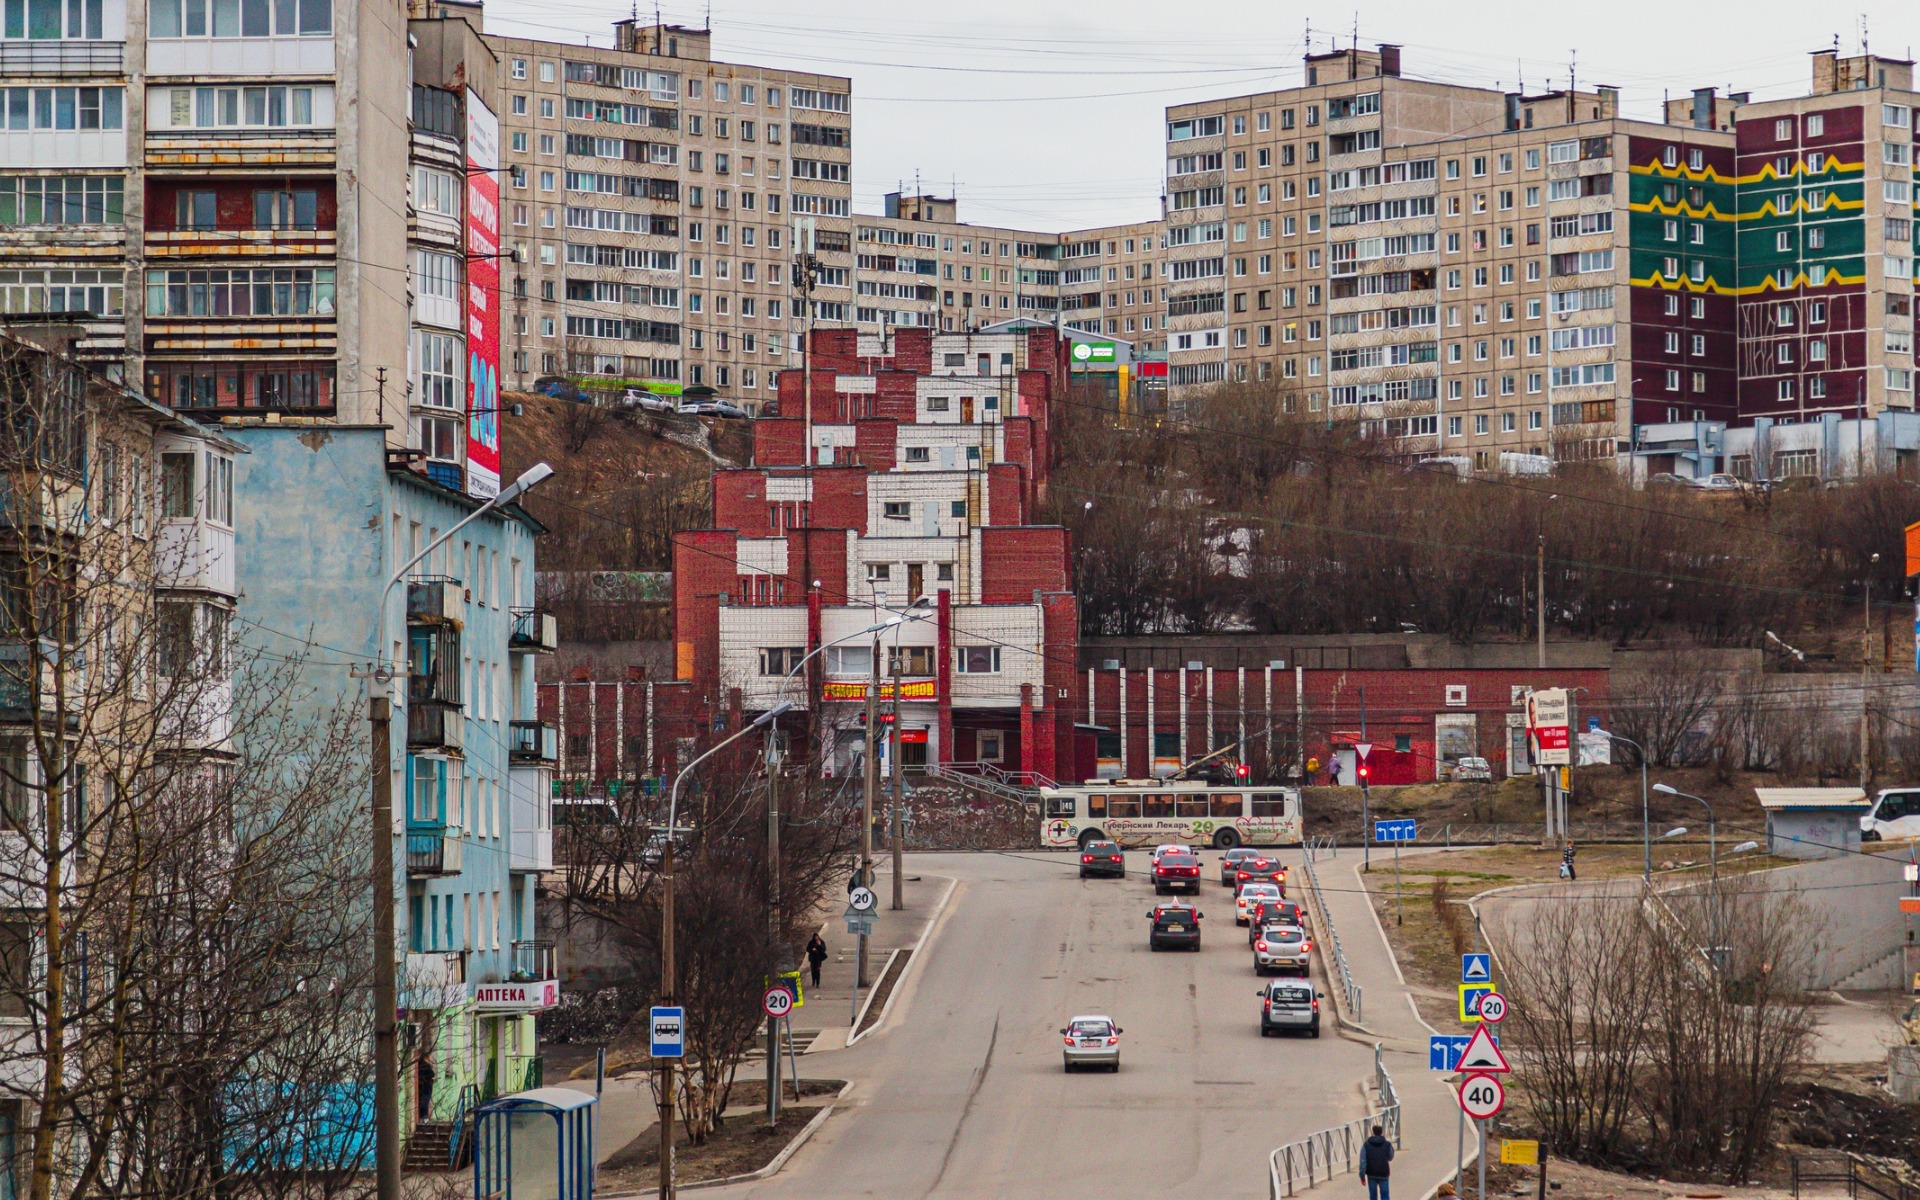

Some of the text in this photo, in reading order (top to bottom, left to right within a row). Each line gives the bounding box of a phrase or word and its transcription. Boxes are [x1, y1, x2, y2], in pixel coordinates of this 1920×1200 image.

[470, 351, 497, 447] 200
[1062, 802, 1073, 810] 140
[1102, 821, 1189, 830] Губернский Лекарь
[1192, 821, 1214, 834] 20
[854, 893, 869, 904] 20
[477, 988, 525, 1001] АПТЕКА
[768, 995, 788, 1009] 20
[1484, 1002, 1502, 1015] 20
[1468, 1087, 1495, 1105] 40
